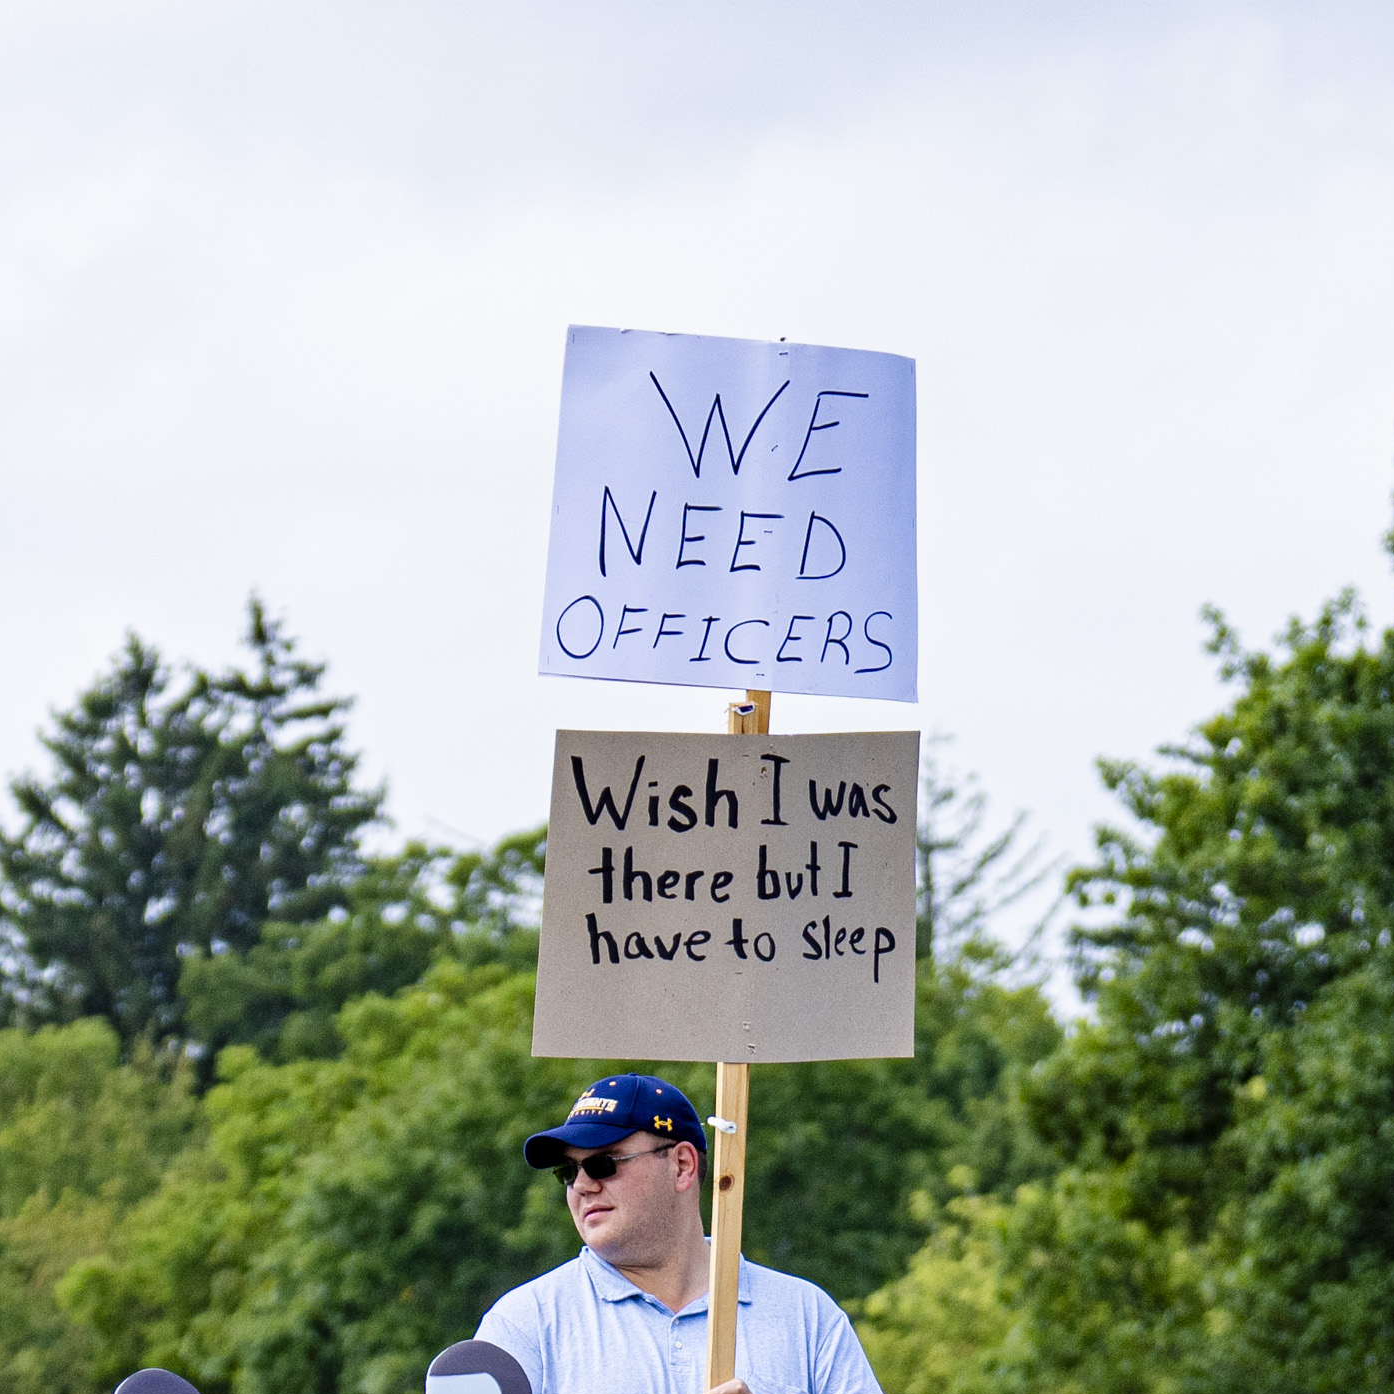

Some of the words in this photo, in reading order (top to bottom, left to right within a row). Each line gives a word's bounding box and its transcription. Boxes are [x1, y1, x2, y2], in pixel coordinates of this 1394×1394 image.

[650, 370, 871, 483] WE
[599, 485, 848, 581] NEED
[555, 594, 894, 675] OFFICERS
[571, 754, 740, 833] Wish
[760, 754, 791, 828] I
[809, 780, 899, 826] was
[588, 846, 735, 906] there
[757, 840, 821, 902] but
[834, 841, 860, 900] I
[586, 912, 713, 967] have
[727, 918, 777, 963] to
[801, 914, 897, 985] sleep
